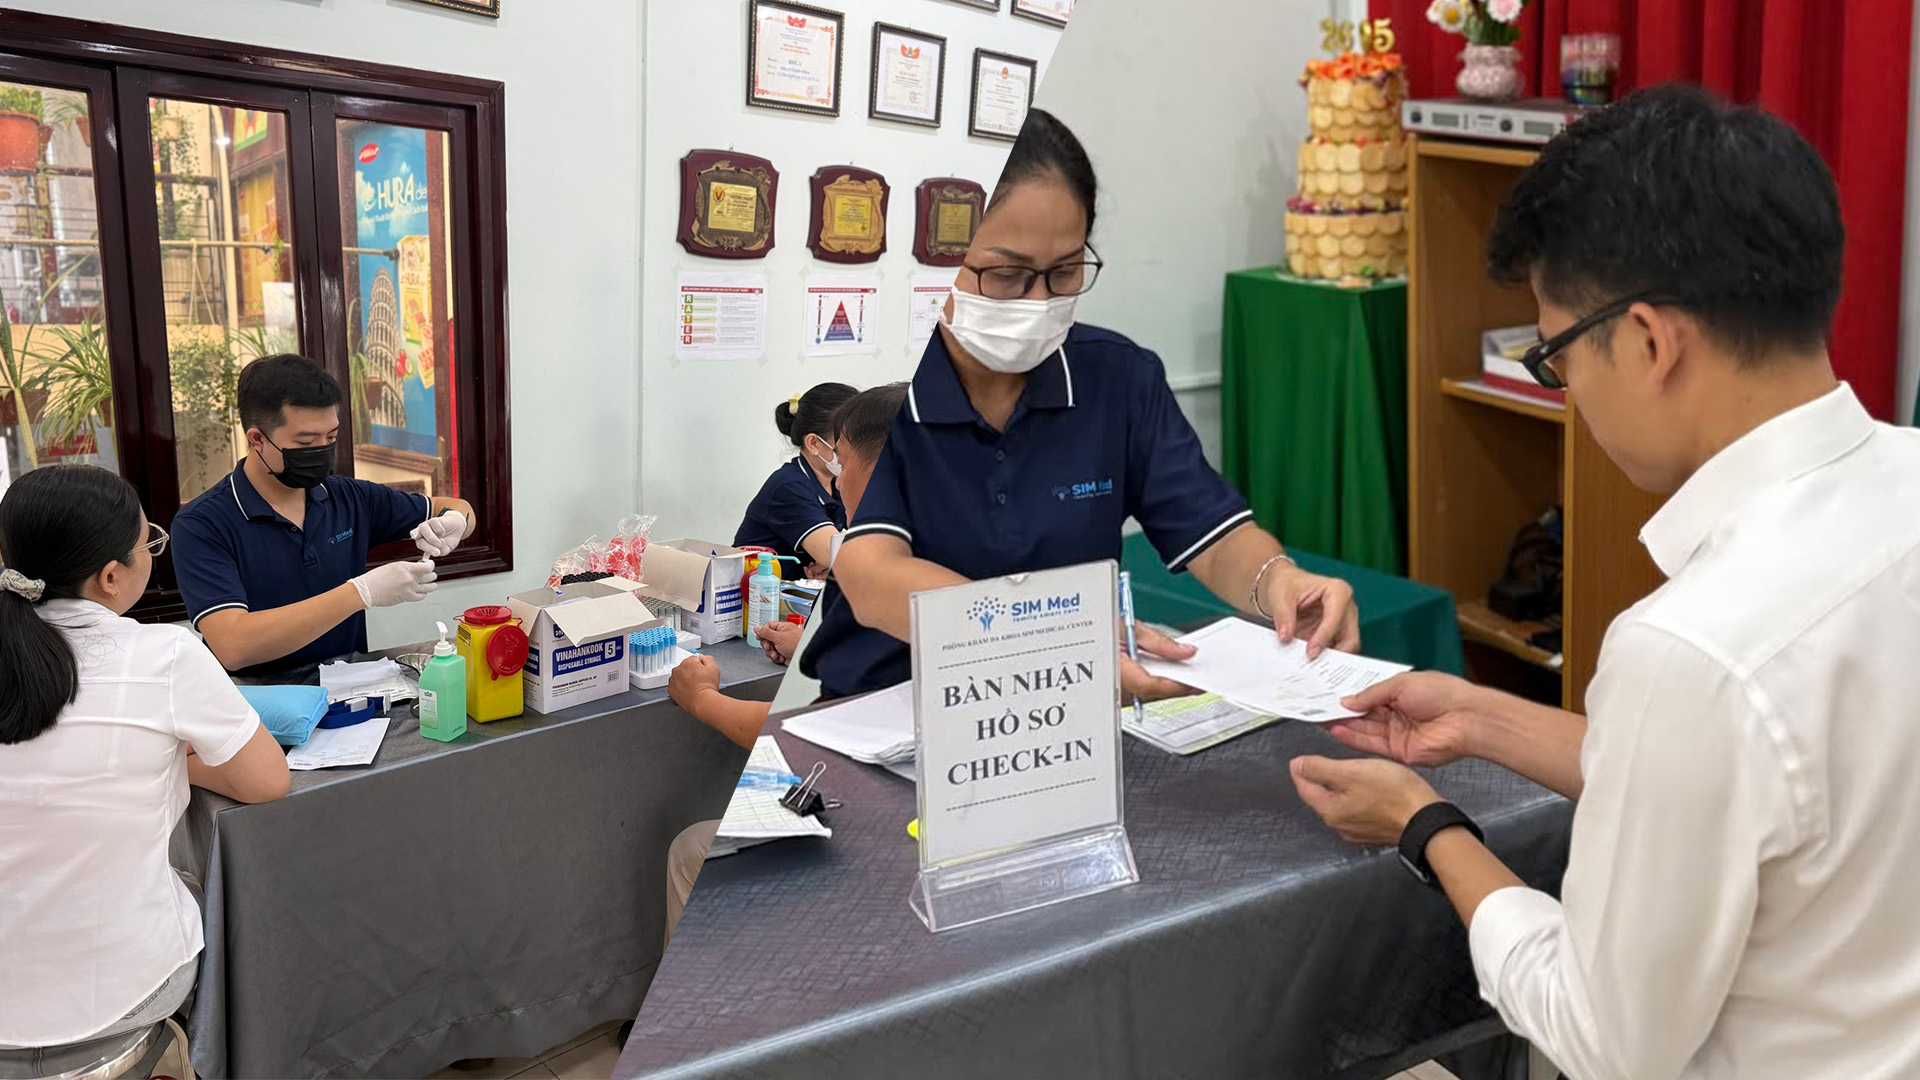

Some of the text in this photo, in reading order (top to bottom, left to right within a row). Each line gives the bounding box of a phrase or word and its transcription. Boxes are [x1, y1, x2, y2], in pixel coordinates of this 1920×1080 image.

[377, 172, 414, 210] HURA
[1072, 481, 1097, 495] SIM
[1011, 593, 1080, 616] SIM Med
[1012, 614, 1038, 623] family
[1022, 629, 1035, 638] SIM
[1035, 625, 1066, 635] MEDICAL
[1067, 620, 1094, 630] CENTER
[556, 642, 604, 662] VINAHANKOOK
[607, 644, 614, 655] 5
[558, 655, 602, 671] DISPOSABLE SYRINGE
[943, 661, 1094, 708] BÀN NHẬN
[976, 702, 1066, 741] HỒ SƠ
[947, 738, 1092, 786] CHECK-IN
